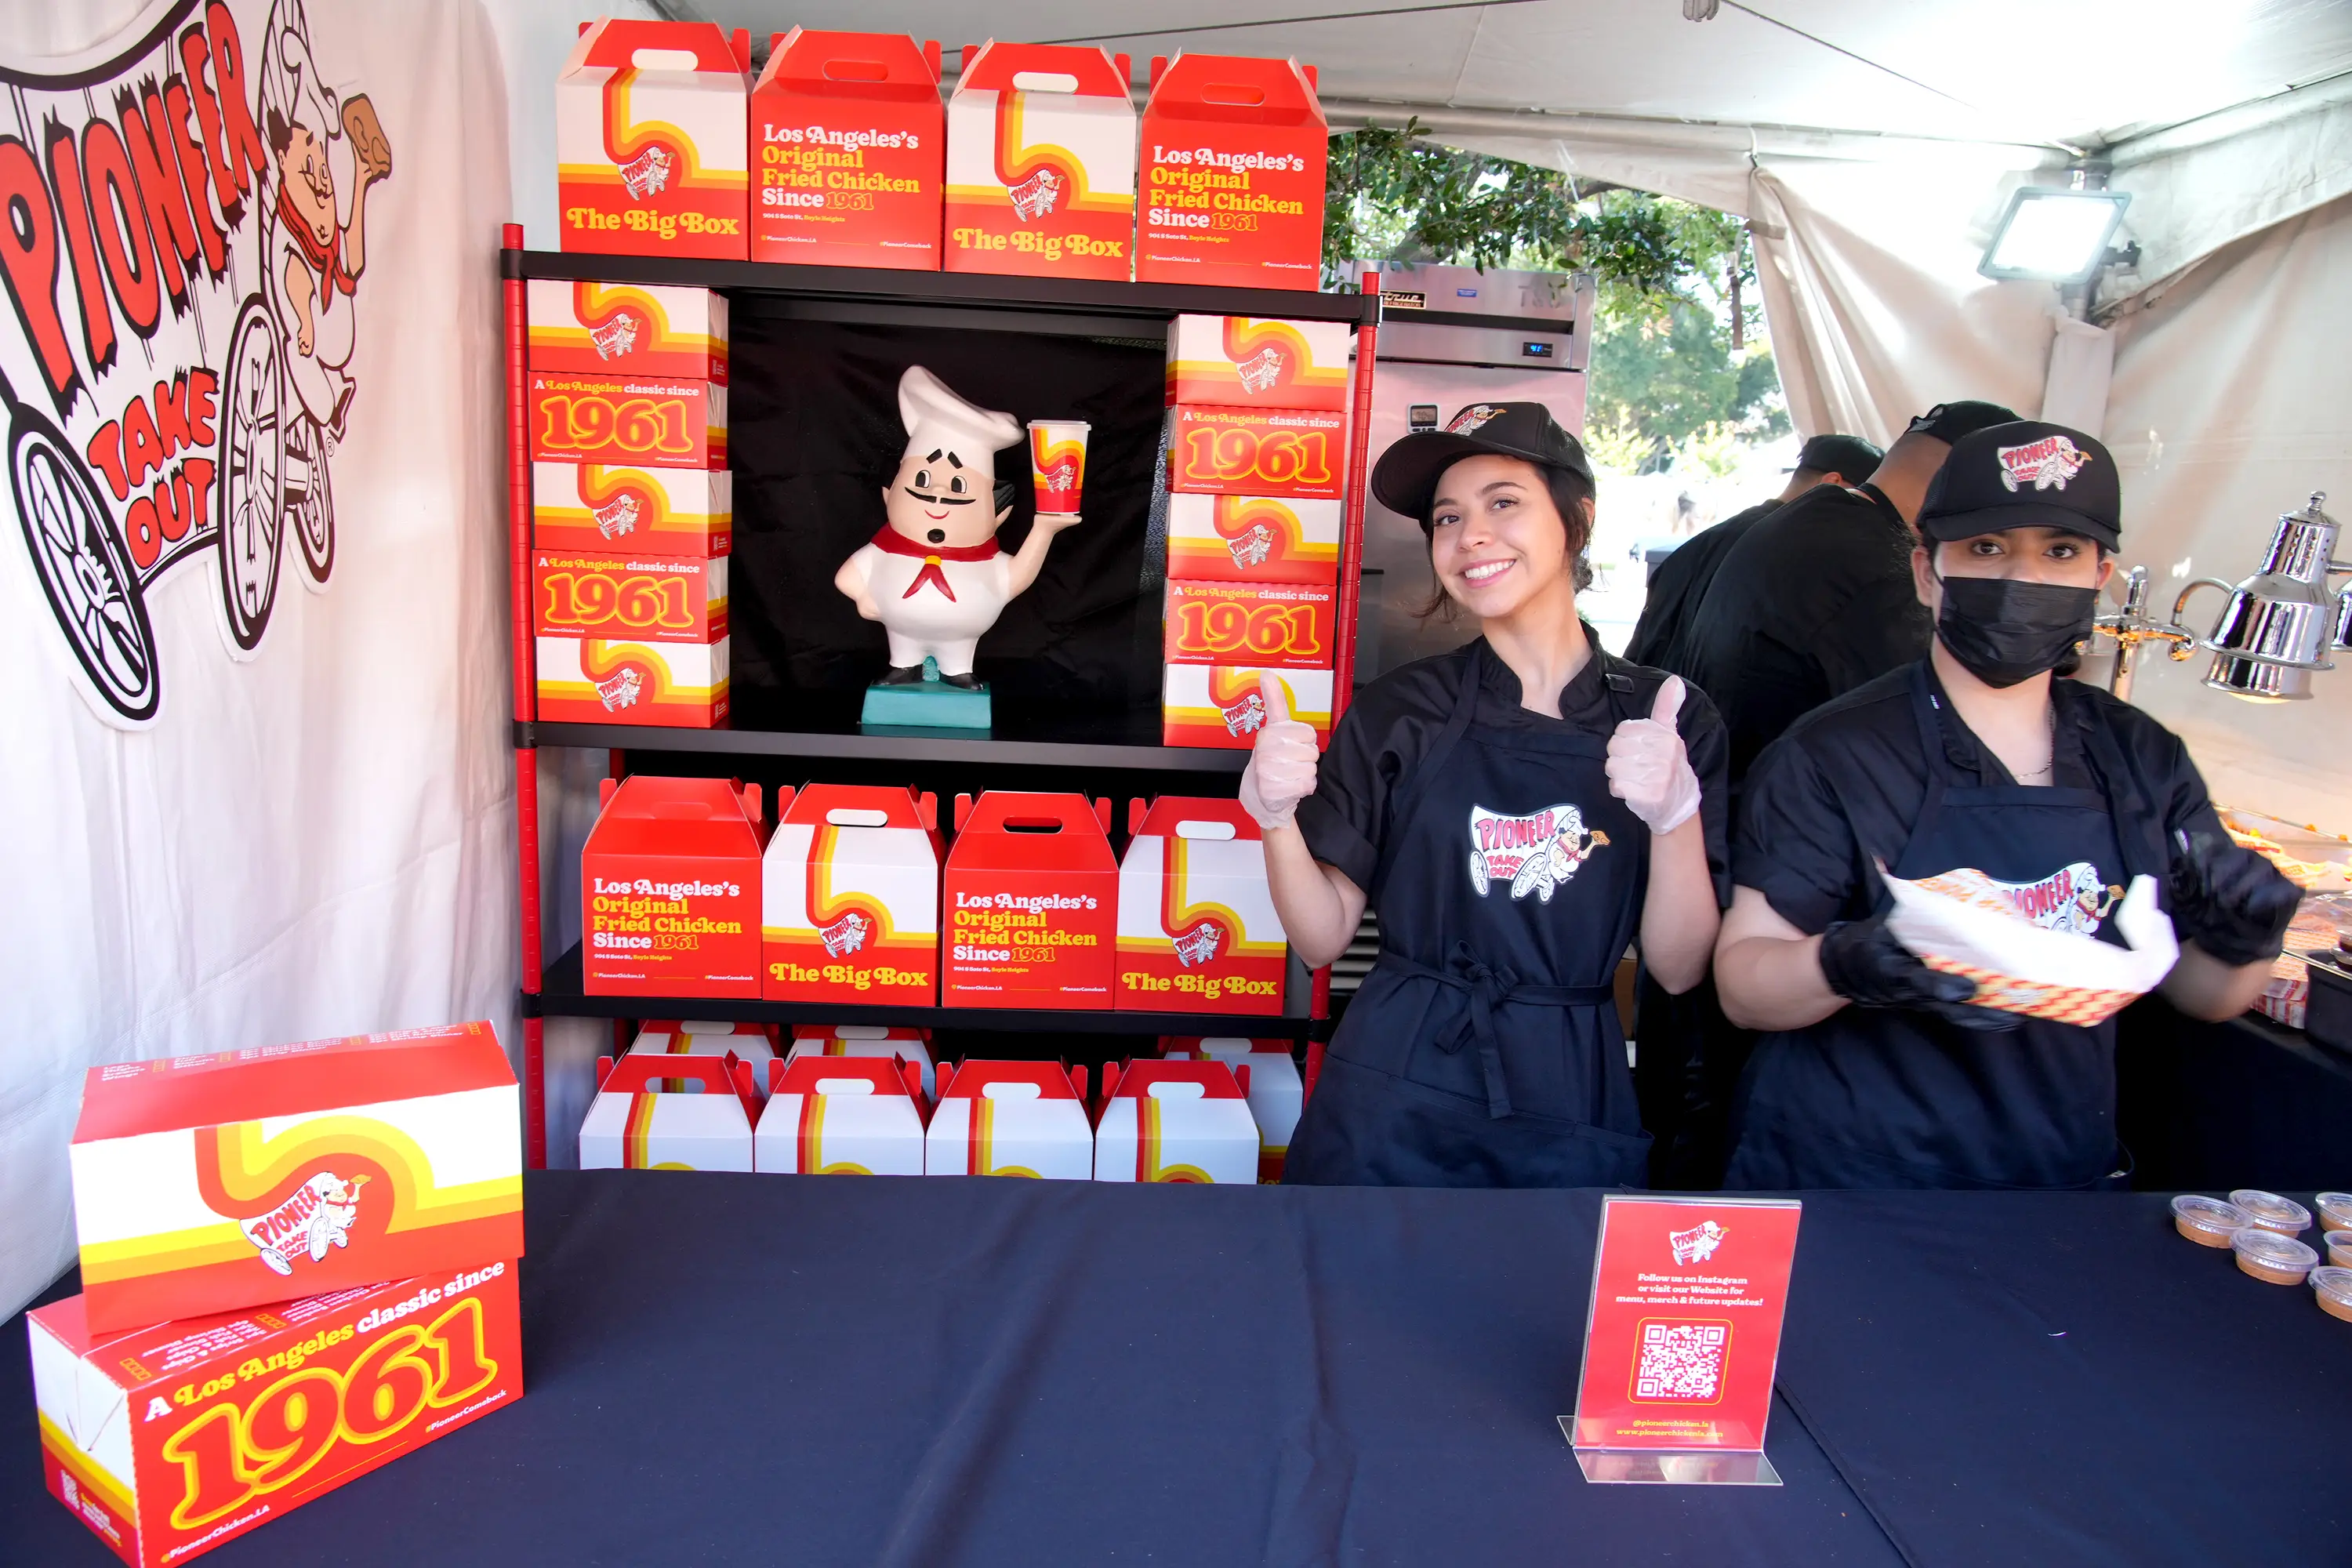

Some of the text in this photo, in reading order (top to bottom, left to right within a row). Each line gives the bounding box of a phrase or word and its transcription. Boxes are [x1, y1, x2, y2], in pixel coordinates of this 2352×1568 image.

[764, 124, 919, 152] Los Angeles's
[762, 146, 863, 172] Original
[1152, 146, 1304, 174] Los Angeles's
[762, 169, 920, 194] Fried Chicken
[1011, 175, 1043, 204] PIONEER
[1151, 167, 1250, 193] Original
[0, 2, 269, 409] PIONEER
[762, 189, 874, 210] Since 1961
[1149, 189, 1304, 215] Fried Chicken
[566, 208, 739, 240] The Big Box
[1149, 209, 1258, 231] Since 1961
[953, 228, 1123, 261] The Big Box
[1380, 292, 1422, 303] true
[535, 379, 699, 396] A Los Angeles classic since
[540, 395, 693, 452] 1961
[1183, 412, 1339, 428] A Los Angeles classic since
[86, 365, 220, 503] TAKE
[1185, 427, 1330, 484] 1961
[2001, 437, 2060, 469] PIONEER
[125, 458, 216, 571] OUT
[1229, 529, 1258, 554] PIONEER
[539, 557, 700, 573] A Los Angeles classic since
[543, 572, 694, 627] 1961
[1174, 586, 1329, 601] A Los Angeles classic since
[1178, 601, 1320, 655] 1961
[1225, 699, 1252, 722] PIONEER
[1475, 809, 1556, 852] PIONEER
[1486, 854, 1524, 869] TAKE
[1490, 866, 1516, 878] OUT
[593, 878, 739, 901] Los Angeles's
[593, 897, 688, 919] Original
[956, 892, 1097, 914] Los Angeles's
[593, 916, 742, 934] Fried Chicken
[822, 918, 851, 942] PIONEER
[953, 910, 1047, 932] Original
[593, 932, 699, 950] Since 1961
[953, 929, 1097, 946] Fried Chicken
[1175, 927, 1204, 953] PIONEER
[953, 946, 1055, 963] Since 1961
[769, 964, 929, 991] The Big Box
[1121, 972, 1277, 1000] The Big Box
[250, 1185, 322, 1247] PIONEER
[276, 1231, 308, 1251] TAKE
[1672, 1225, 1706, 1248] PIONEER
[285, 1242, 307, 1258] OUT
[1638, 1273, 1671, 1282] Follow
[1697, 1276, 1748, 1285] Instagram
[1690, 1286, 1730, 1294] Website
[1730, 1287, 1744, 1295] for
[1688, 1296, 1720, 1305] future
[1721, 1298, 1763, 1306] updates!
[145, 1396, 172, 1423] A
[174, 1370, 236, 1406] Los
[238, 1323, 355, 1383] Angeles
[356, 1289, 442, 1334] classic
[443, 1261, 505, 1298] since
[162, 1297, 498, 1530] 1961
